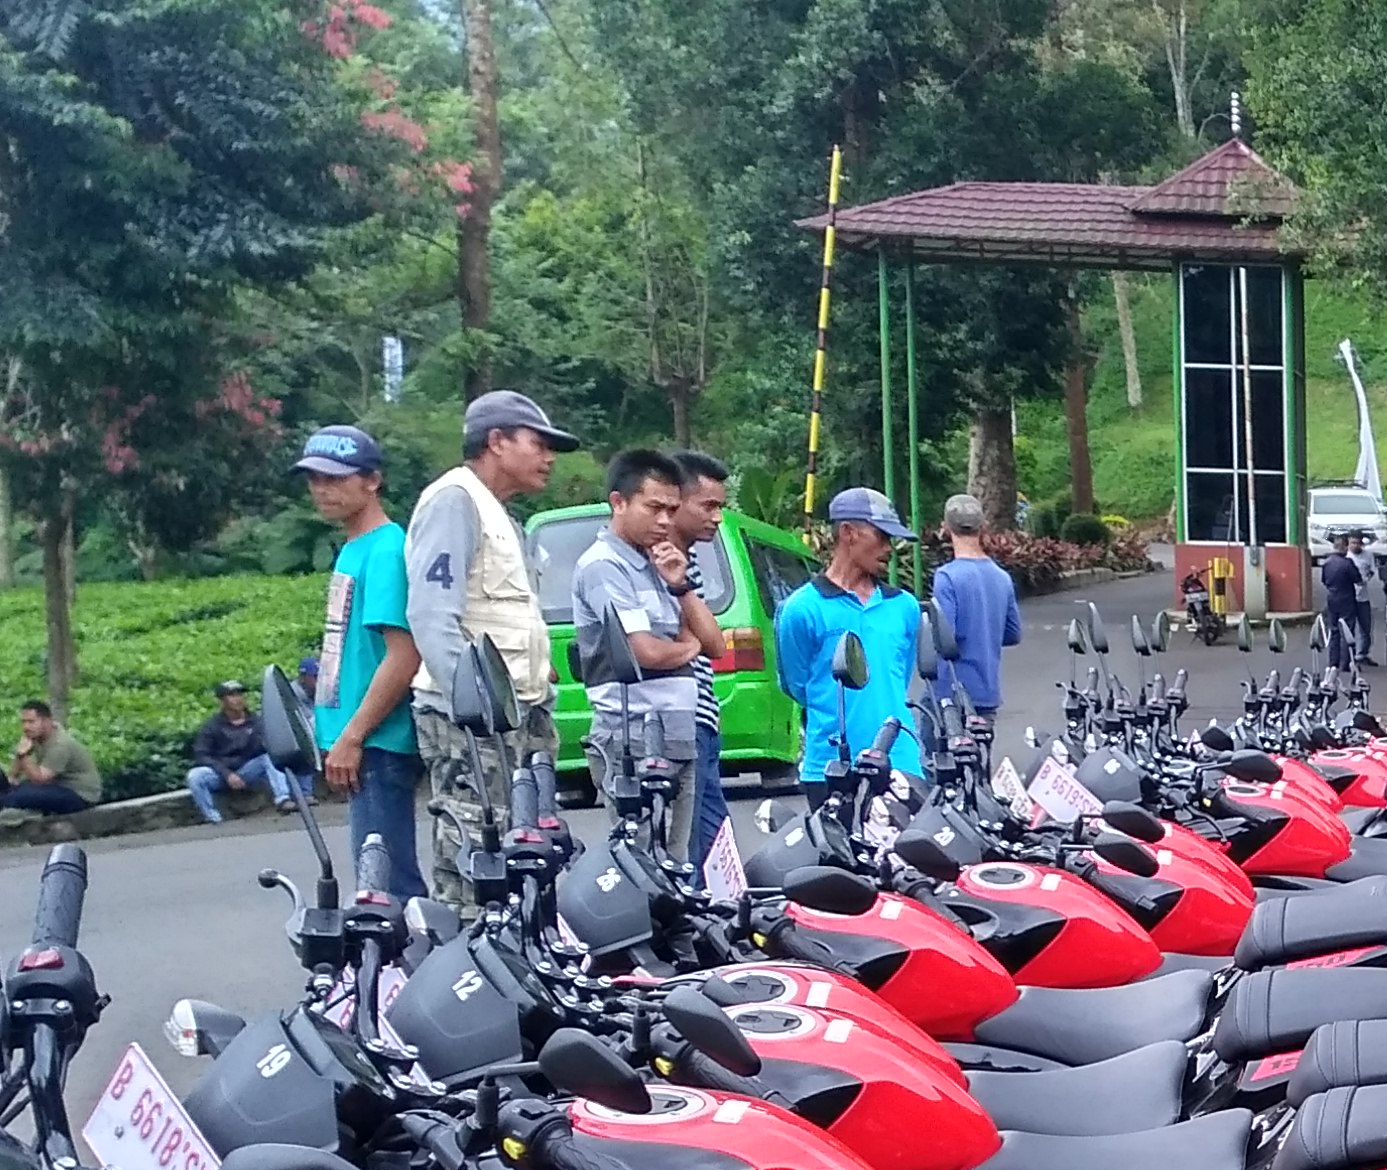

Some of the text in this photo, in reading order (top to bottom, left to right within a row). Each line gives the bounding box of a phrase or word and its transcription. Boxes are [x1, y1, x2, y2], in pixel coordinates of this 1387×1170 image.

[426, 552, 453, 590] 4
[451, 969, 484, 1002] 12
[256, 1043, 292, 1079] 19
[110, 1061, 133, 1100] B
[130, 1087, 182, 1167] 6618
